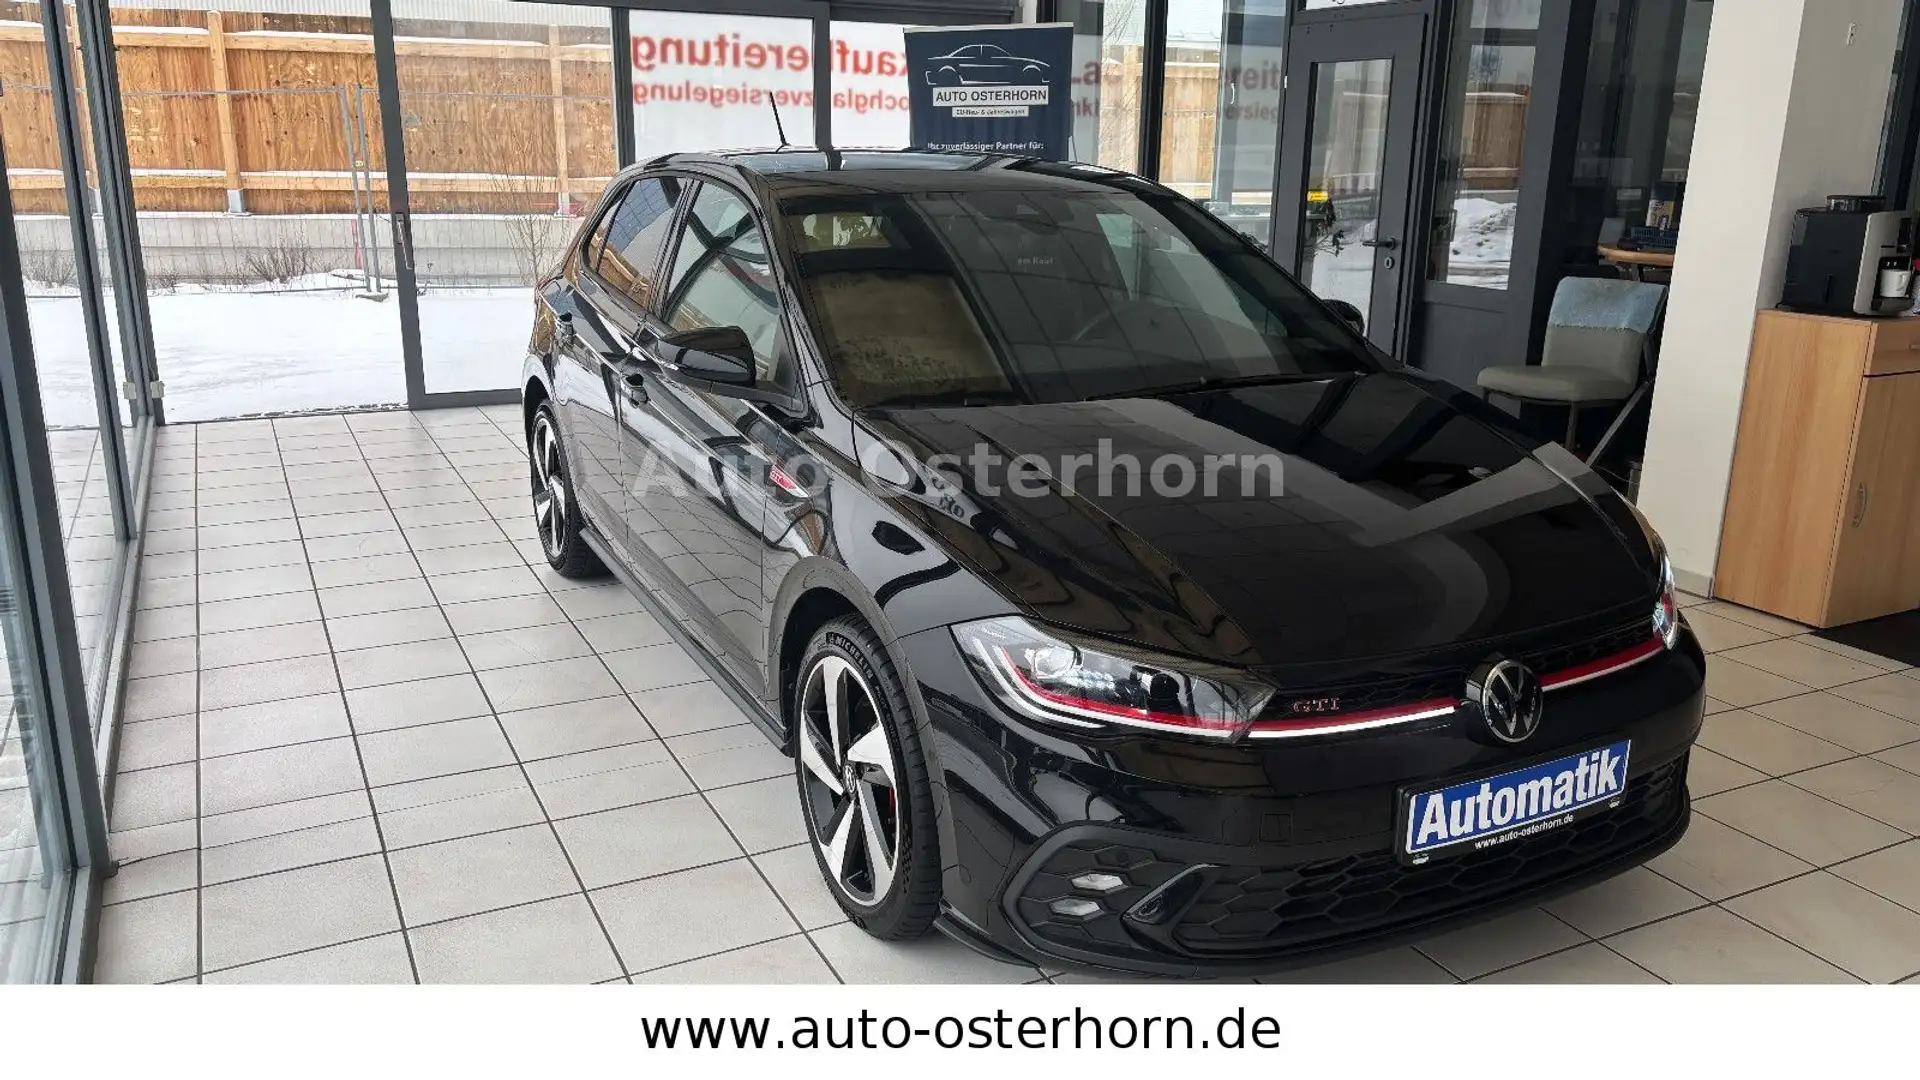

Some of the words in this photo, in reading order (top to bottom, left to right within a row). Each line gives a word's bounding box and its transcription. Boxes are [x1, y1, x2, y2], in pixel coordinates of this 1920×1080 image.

[935, 91, 968, 102] AUTO
[970, 89, 1047, 101] OSTERHORN
[940, 141, 994, 152] zuverlässiger
[996, 141, 1026, 150] Partner
[1029, 141, 1044, 150] für:
[835, 635, 874, 679] MICHELIN
[1292, 697, 1340, 713] GTI
[1416, 749, 1621, 845] Automatik
[1474, 813, 1575, 850] www.auto-osterhorn.de
